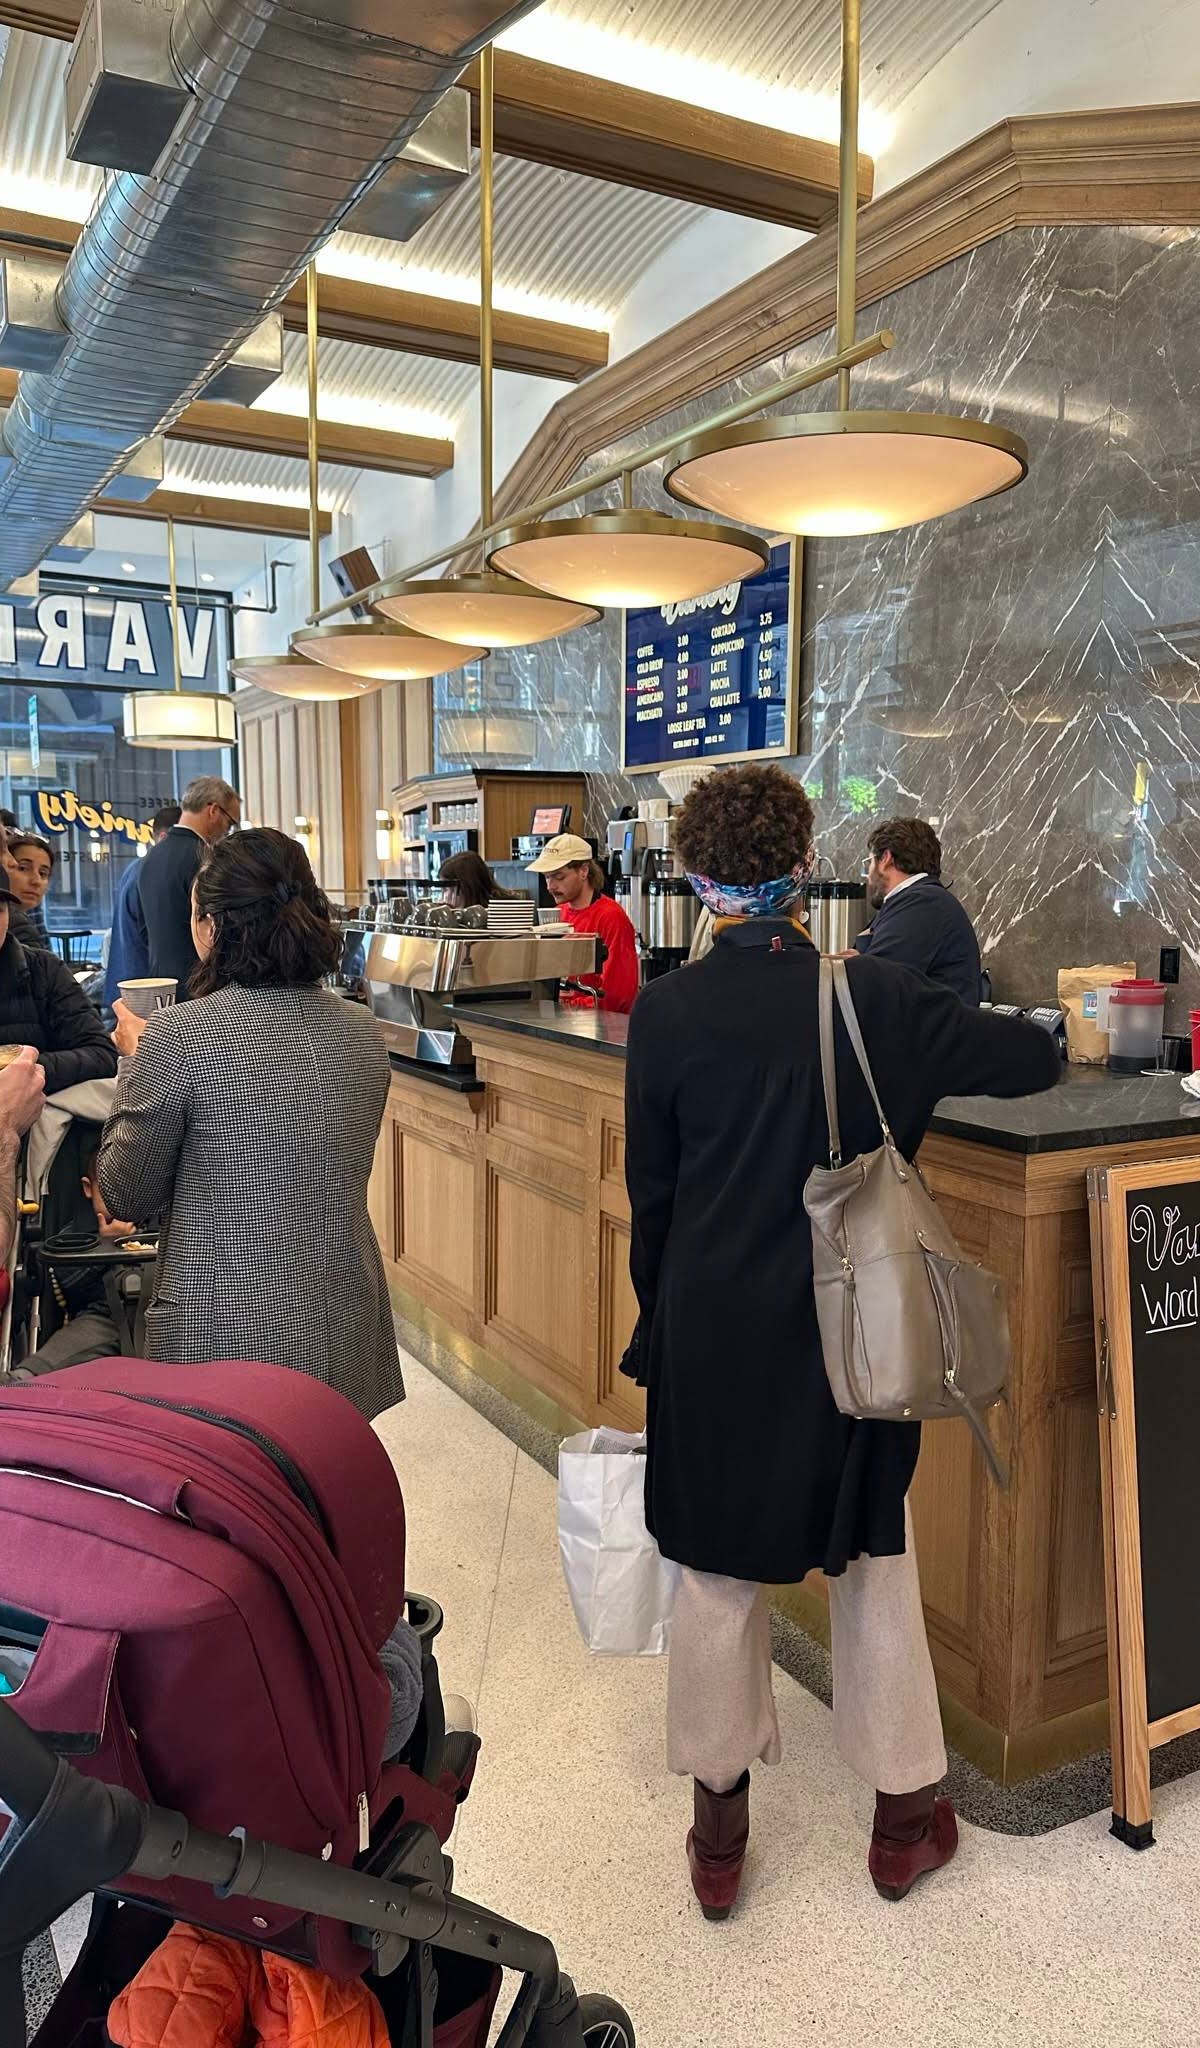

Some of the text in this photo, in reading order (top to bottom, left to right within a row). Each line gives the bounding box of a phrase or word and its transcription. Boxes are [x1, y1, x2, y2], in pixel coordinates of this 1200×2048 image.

[711, 611, 772, 639] CORTADO 3.75
[636, 644, 654, 659] COFFEE
[711, 630, 773, 656] CAPPUCCINO 4.00
[636, 651, 689, 674] COLD BREW 4.00
[710, 649, 773, 674] LATTE 4.50
[636, 668, 689, 690] ESPRESSO 3.00
[710, 667, 772, 691] MOCHA 5.00
[636, 691, 665, 706] AMERICANO
[710, 685, 771, 708] CHAI LATTE 5.00
[636, 701, 689, 721] MACCHIATO 3.50
[668, 712, 732, 735] LOOSE LEAF TEA 3.00
[1140, 1276, 1199, 1326] Word
